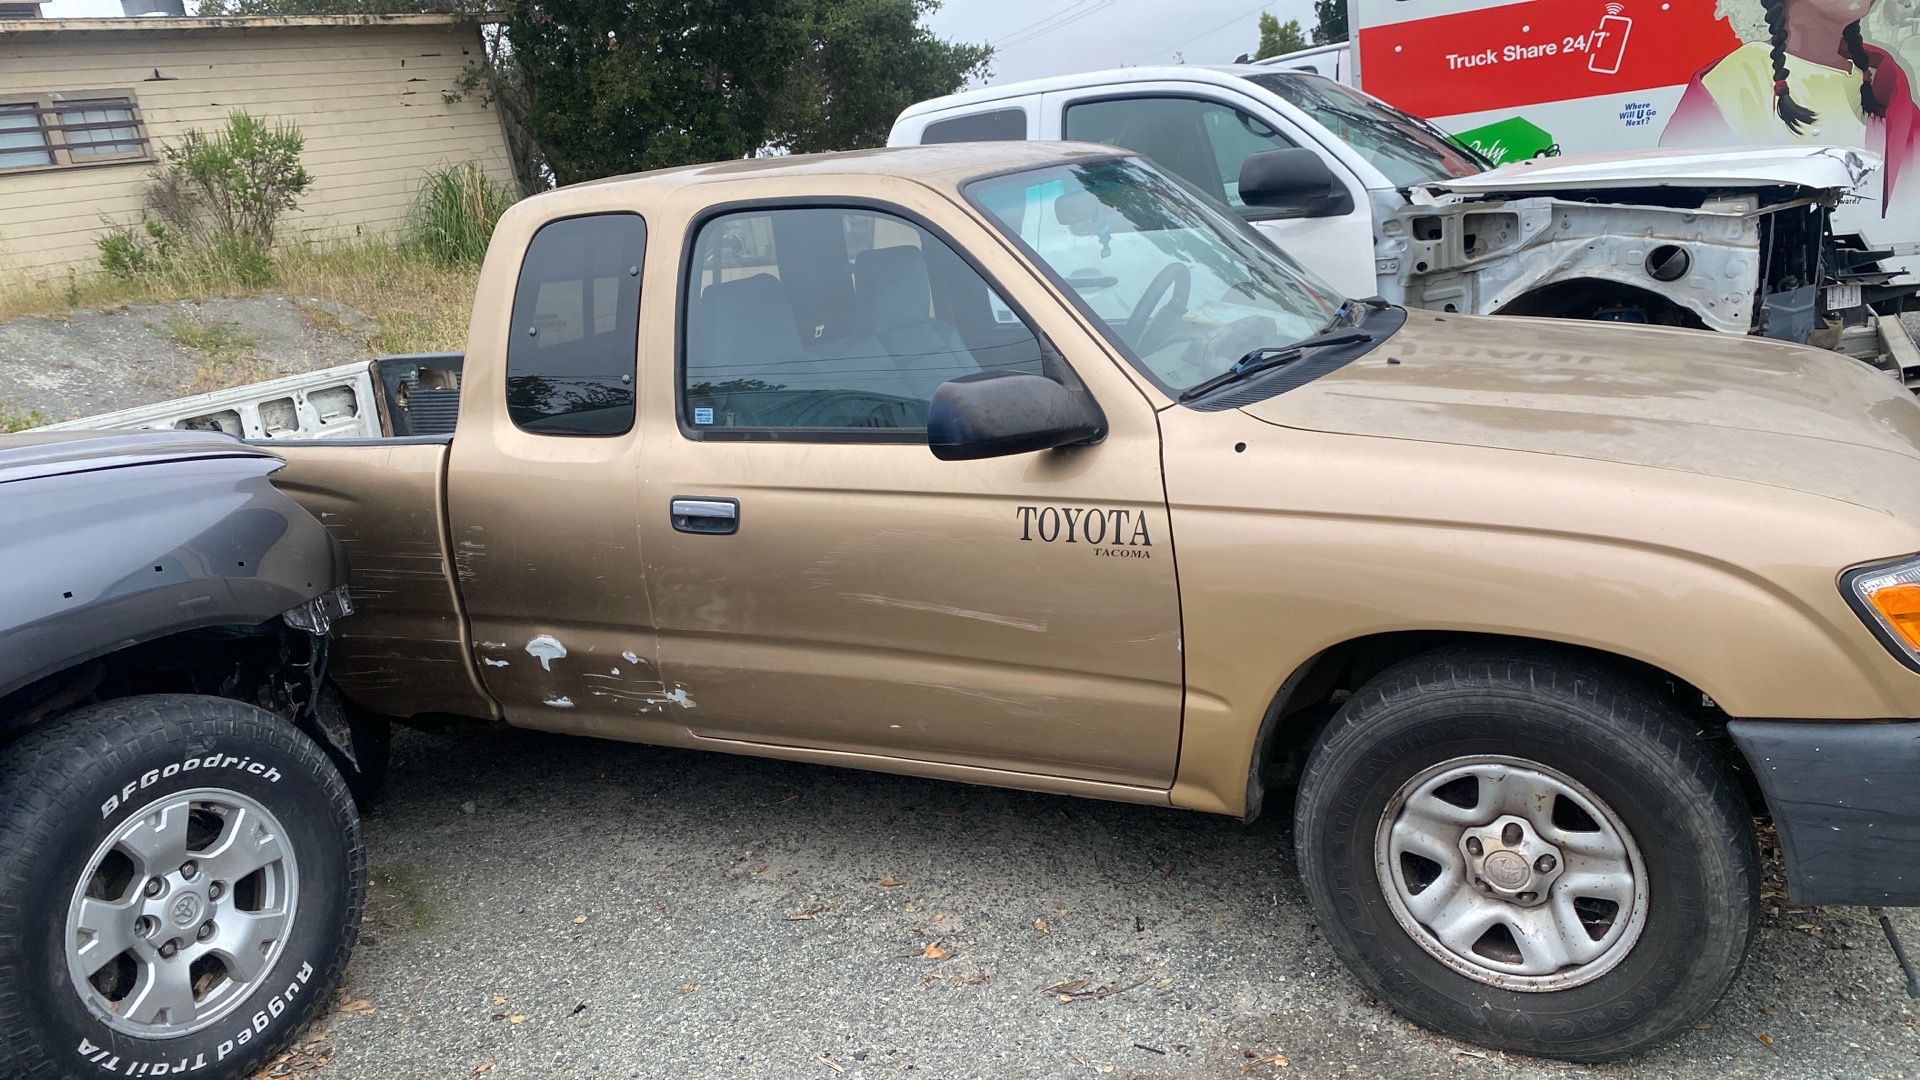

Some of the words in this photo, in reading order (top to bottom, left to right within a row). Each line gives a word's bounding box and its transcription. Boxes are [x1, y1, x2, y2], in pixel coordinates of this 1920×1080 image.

[1446, 49, 1498, 70] Truck
[1503, 42, 1558, 62] Share
[1563, 30, 1606, 54] 24/7
[1619, 111, 1635, 120] Will
[1637, 110, 1644, 119] U
[1646, 109, 1657, 117] Go
[1625, 102, 1651, 111] Where
[1625, 117, 1651, 127] Next?
[1016, 506, 1153, 547] TOYOTA
[1093, 548, 1151, 559] TACOMA
[101, 753, 282, 819] BFGoodrich
[217, 961, 314, 1062] Rugged
[77, 1038, 120, 1072] T/A
[126, 1053, 207, 1078] Trail
